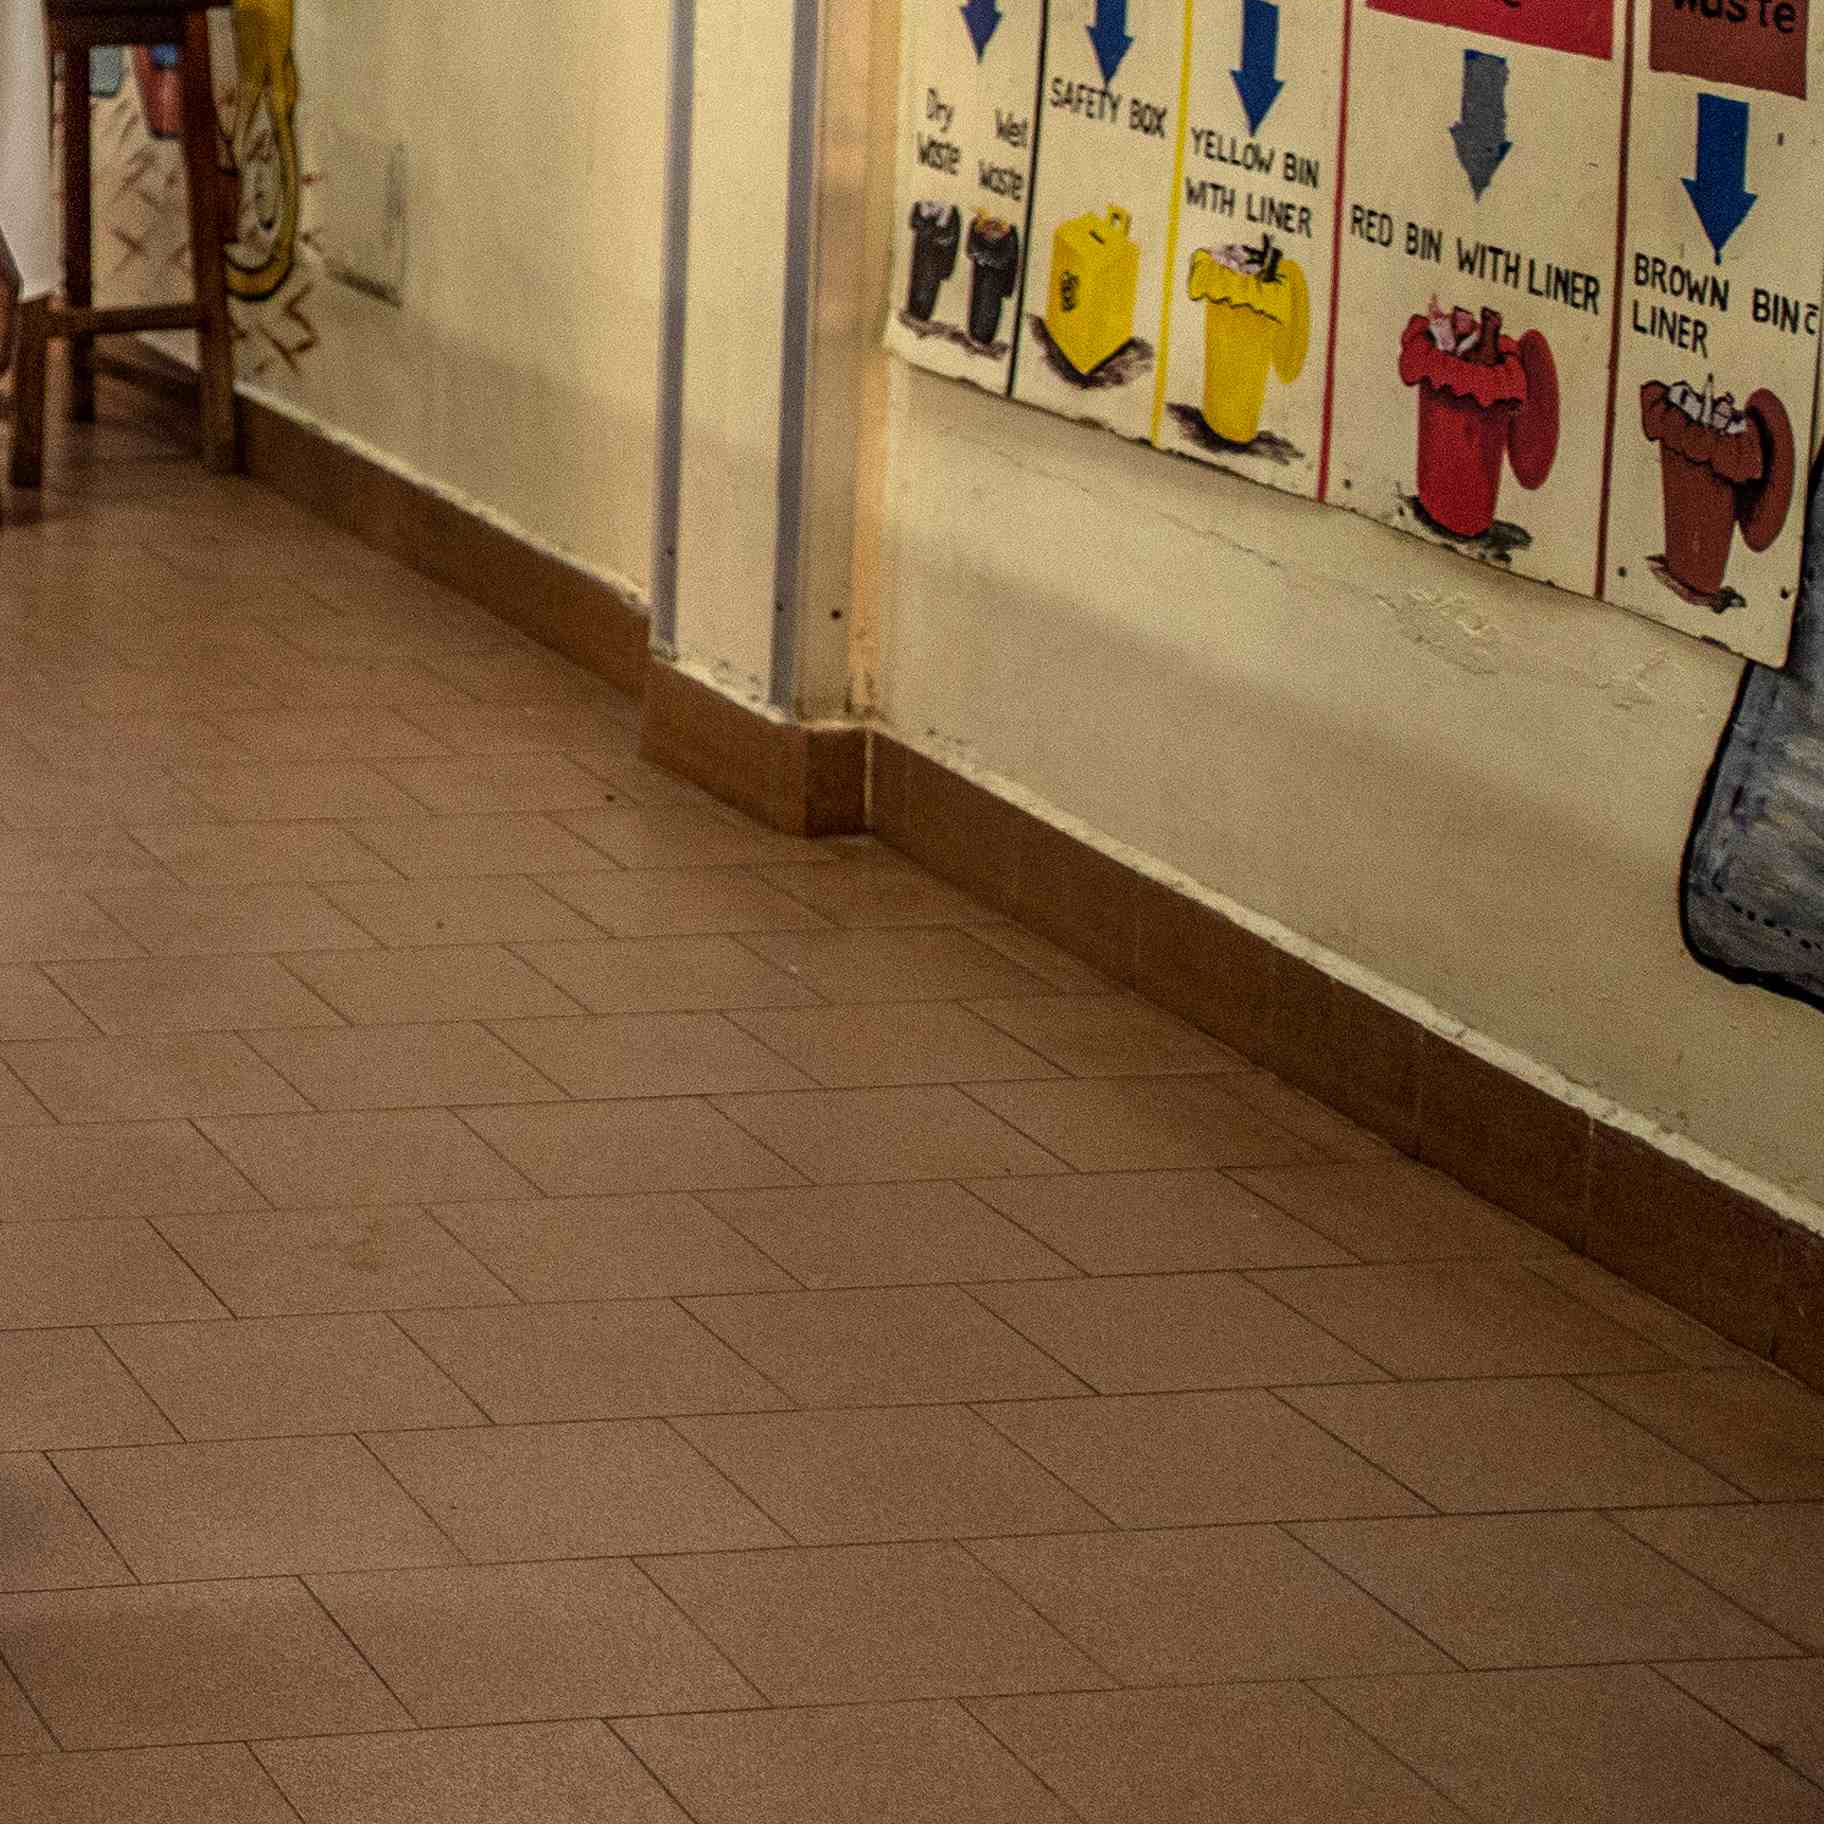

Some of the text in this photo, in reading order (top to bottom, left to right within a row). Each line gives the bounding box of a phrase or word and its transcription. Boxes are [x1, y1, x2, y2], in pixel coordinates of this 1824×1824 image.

[1049, 76, 1168, 140] SAFETY BOX
[1190, 125, 1320, 191] YELLOW BIN
[1184, 177, 1314, 239] WITH LINER
[1350, 204, 1602, 316] RED BIN WITH LINER
[1633, 251, 1731, 313] BROWN
[1752, 286, 1799, 333] BIN
[1631, 299, 1710, 360] LINER
